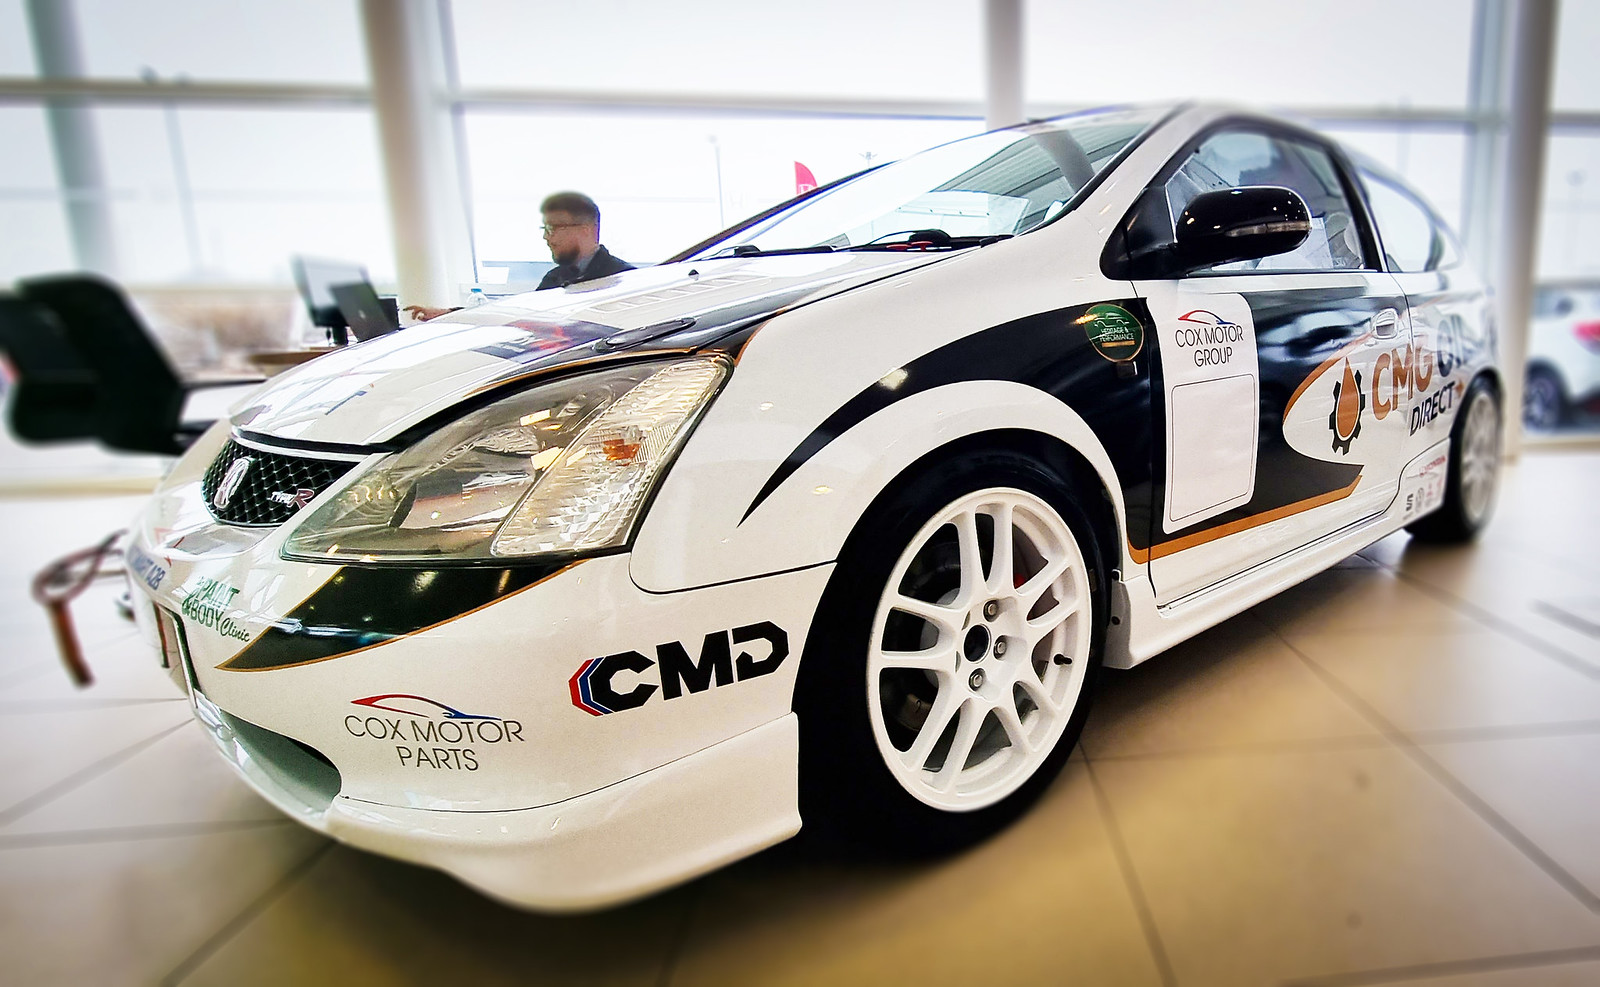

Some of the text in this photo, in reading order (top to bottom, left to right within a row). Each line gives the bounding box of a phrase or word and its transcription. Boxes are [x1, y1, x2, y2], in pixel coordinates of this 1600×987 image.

[1174, 325, 1244, 348] COX MOTOR
[1193, 346, 1233, 367] GROUP
[1372, 336, 1433, 421] CMG
[1409, 381, 1456, 437] DIRECT
[287, 488, 315, 509] R
[194, 578, 240, 611] PAINT
[220, 617, 250, 643] Clinic
[569, 620, 790, 717] CMD
[344, 714, 525, 744] COX MOTOR
[395, 745, 480, 772] PARTS
